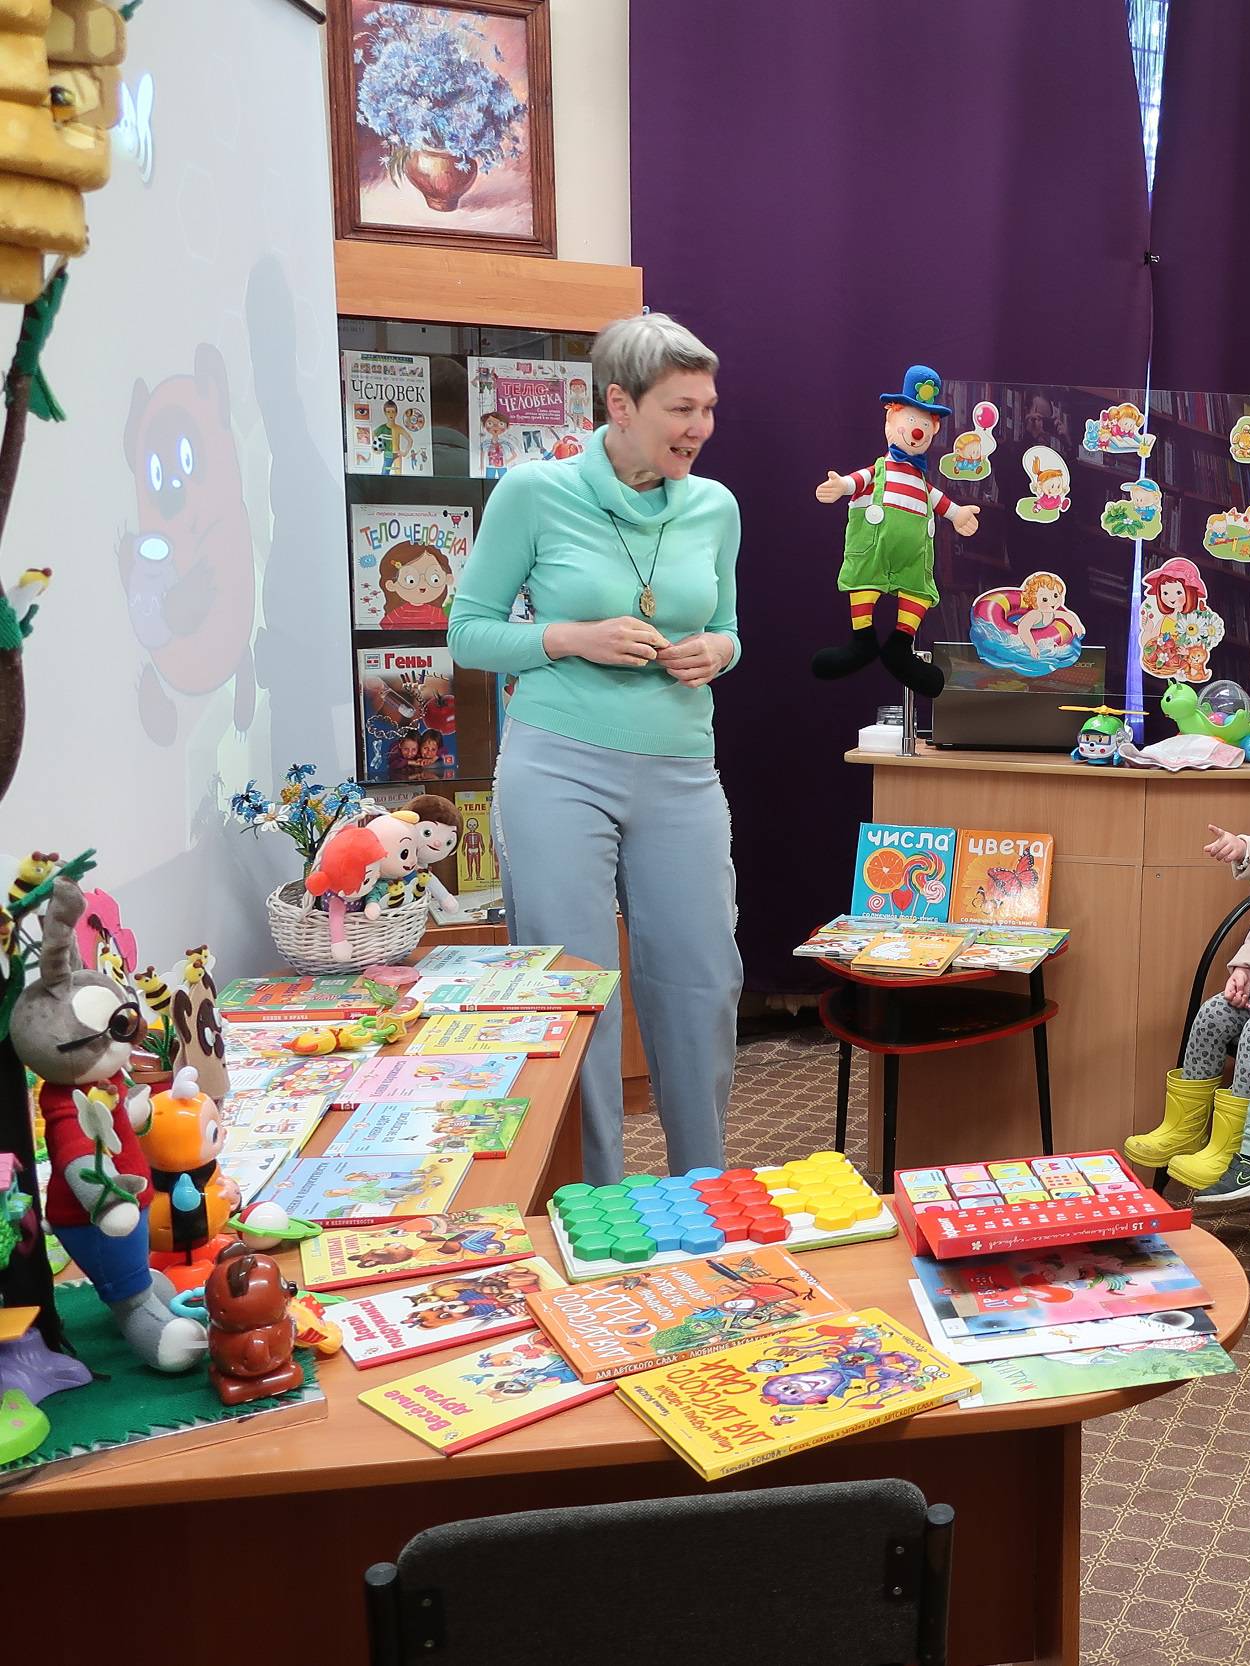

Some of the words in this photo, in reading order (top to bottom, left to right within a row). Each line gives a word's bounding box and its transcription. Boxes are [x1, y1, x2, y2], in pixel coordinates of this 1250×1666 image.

[499, 393, 563, 412] ЧЕЛОВЕКА
[502, 382, 549, 396] ТЕЛО
[360, 518, 400, 550] ТЕЛО
[404, 524, 467, 556] ЧЕЛОВЕКА
[384, 653, 432, 669] Гены
[464, 803, 486, 811] ТЕЛЕ
[1132, 1222, 1144, 1231] 15
[343, 1314, 378, 1342] Давай
[554, 1294, 616, 1341] ДЕТСКОГО
[583, 1285, 657, 1338] САДА
[596, 1369, 611, 1379] ДЛЯ
[614, 1360, 654, 1376] ДЕТСКОГО
[656, 1355, 679, 1366] САДА
[689, 1343, 730, 1358] ЛЮБИМЫЕ
[699, 1359, 757, 1394] САДА
[384, 1390, 452, 1433] Весёлые
[413, 1384, 474, 1416] друзья
[667, 1369, 747, 1421] ДЕТСКОГО
[720, 1462, 749, 1476] Татьяна
[751, 1449, 782, 1466] БОКОВА
[868, 1416, 881, 1429] ДЛЯ
[883, 1407, 916, 1423] ДЕТСКОГО
[917, 1401, 934, 1412] САДА
[722, 1420, 775, 1445] ДЛЯ
